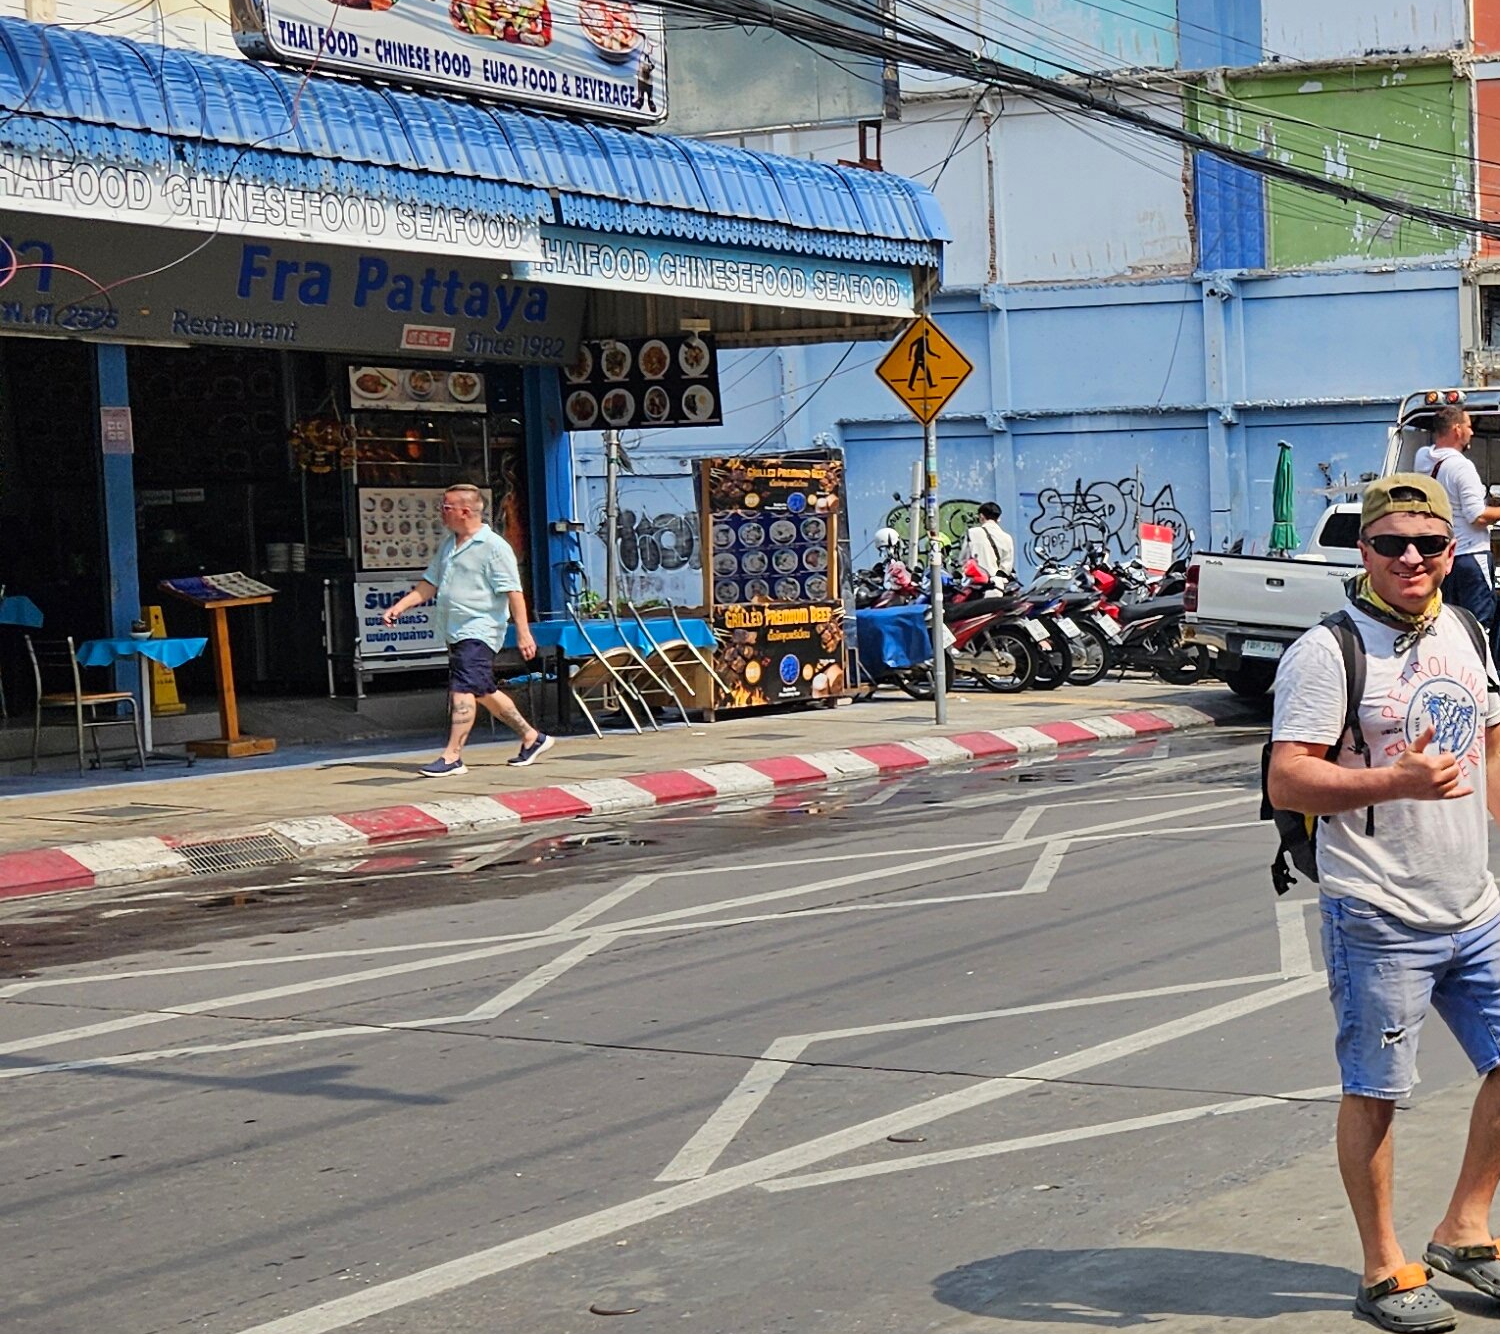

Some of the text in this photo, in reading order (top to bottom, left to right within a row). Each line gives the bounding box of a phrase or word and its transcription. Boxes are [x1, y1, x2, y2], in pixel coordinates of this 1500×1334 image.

[278, 21, 315, 51] THAI
[323, 29, 358, 59] FOOD
[376, 40, 431, 72] CHINESE
[434, 51, 471, 78] FOOD
[483, 59, 518, 87] EURO
[523, 65, 557, 93] FOOD
[562, 75, 571, 96] &
[575, 75, 637, 108] BEVERAGE
[163, 174, 386, 235] CHINESEFOOD
[397, 203, 522, 249] SEAFOOD
[236, 242, 549, 333] Fra Pattaya
[660, 253, 806, 298] CHINESEFOOD
[813, 272, 899, 307] SEAFOOD
[172, 310, 298, 343] Restaurant
[465, 331, 514, 357] Since
[520, 335, 565, 360] 1982
[765, 607, 809, 626] PREMIUM
[810, 606, 832, 623] BEEF
[1382, 656, 1453, 721] PETROL
